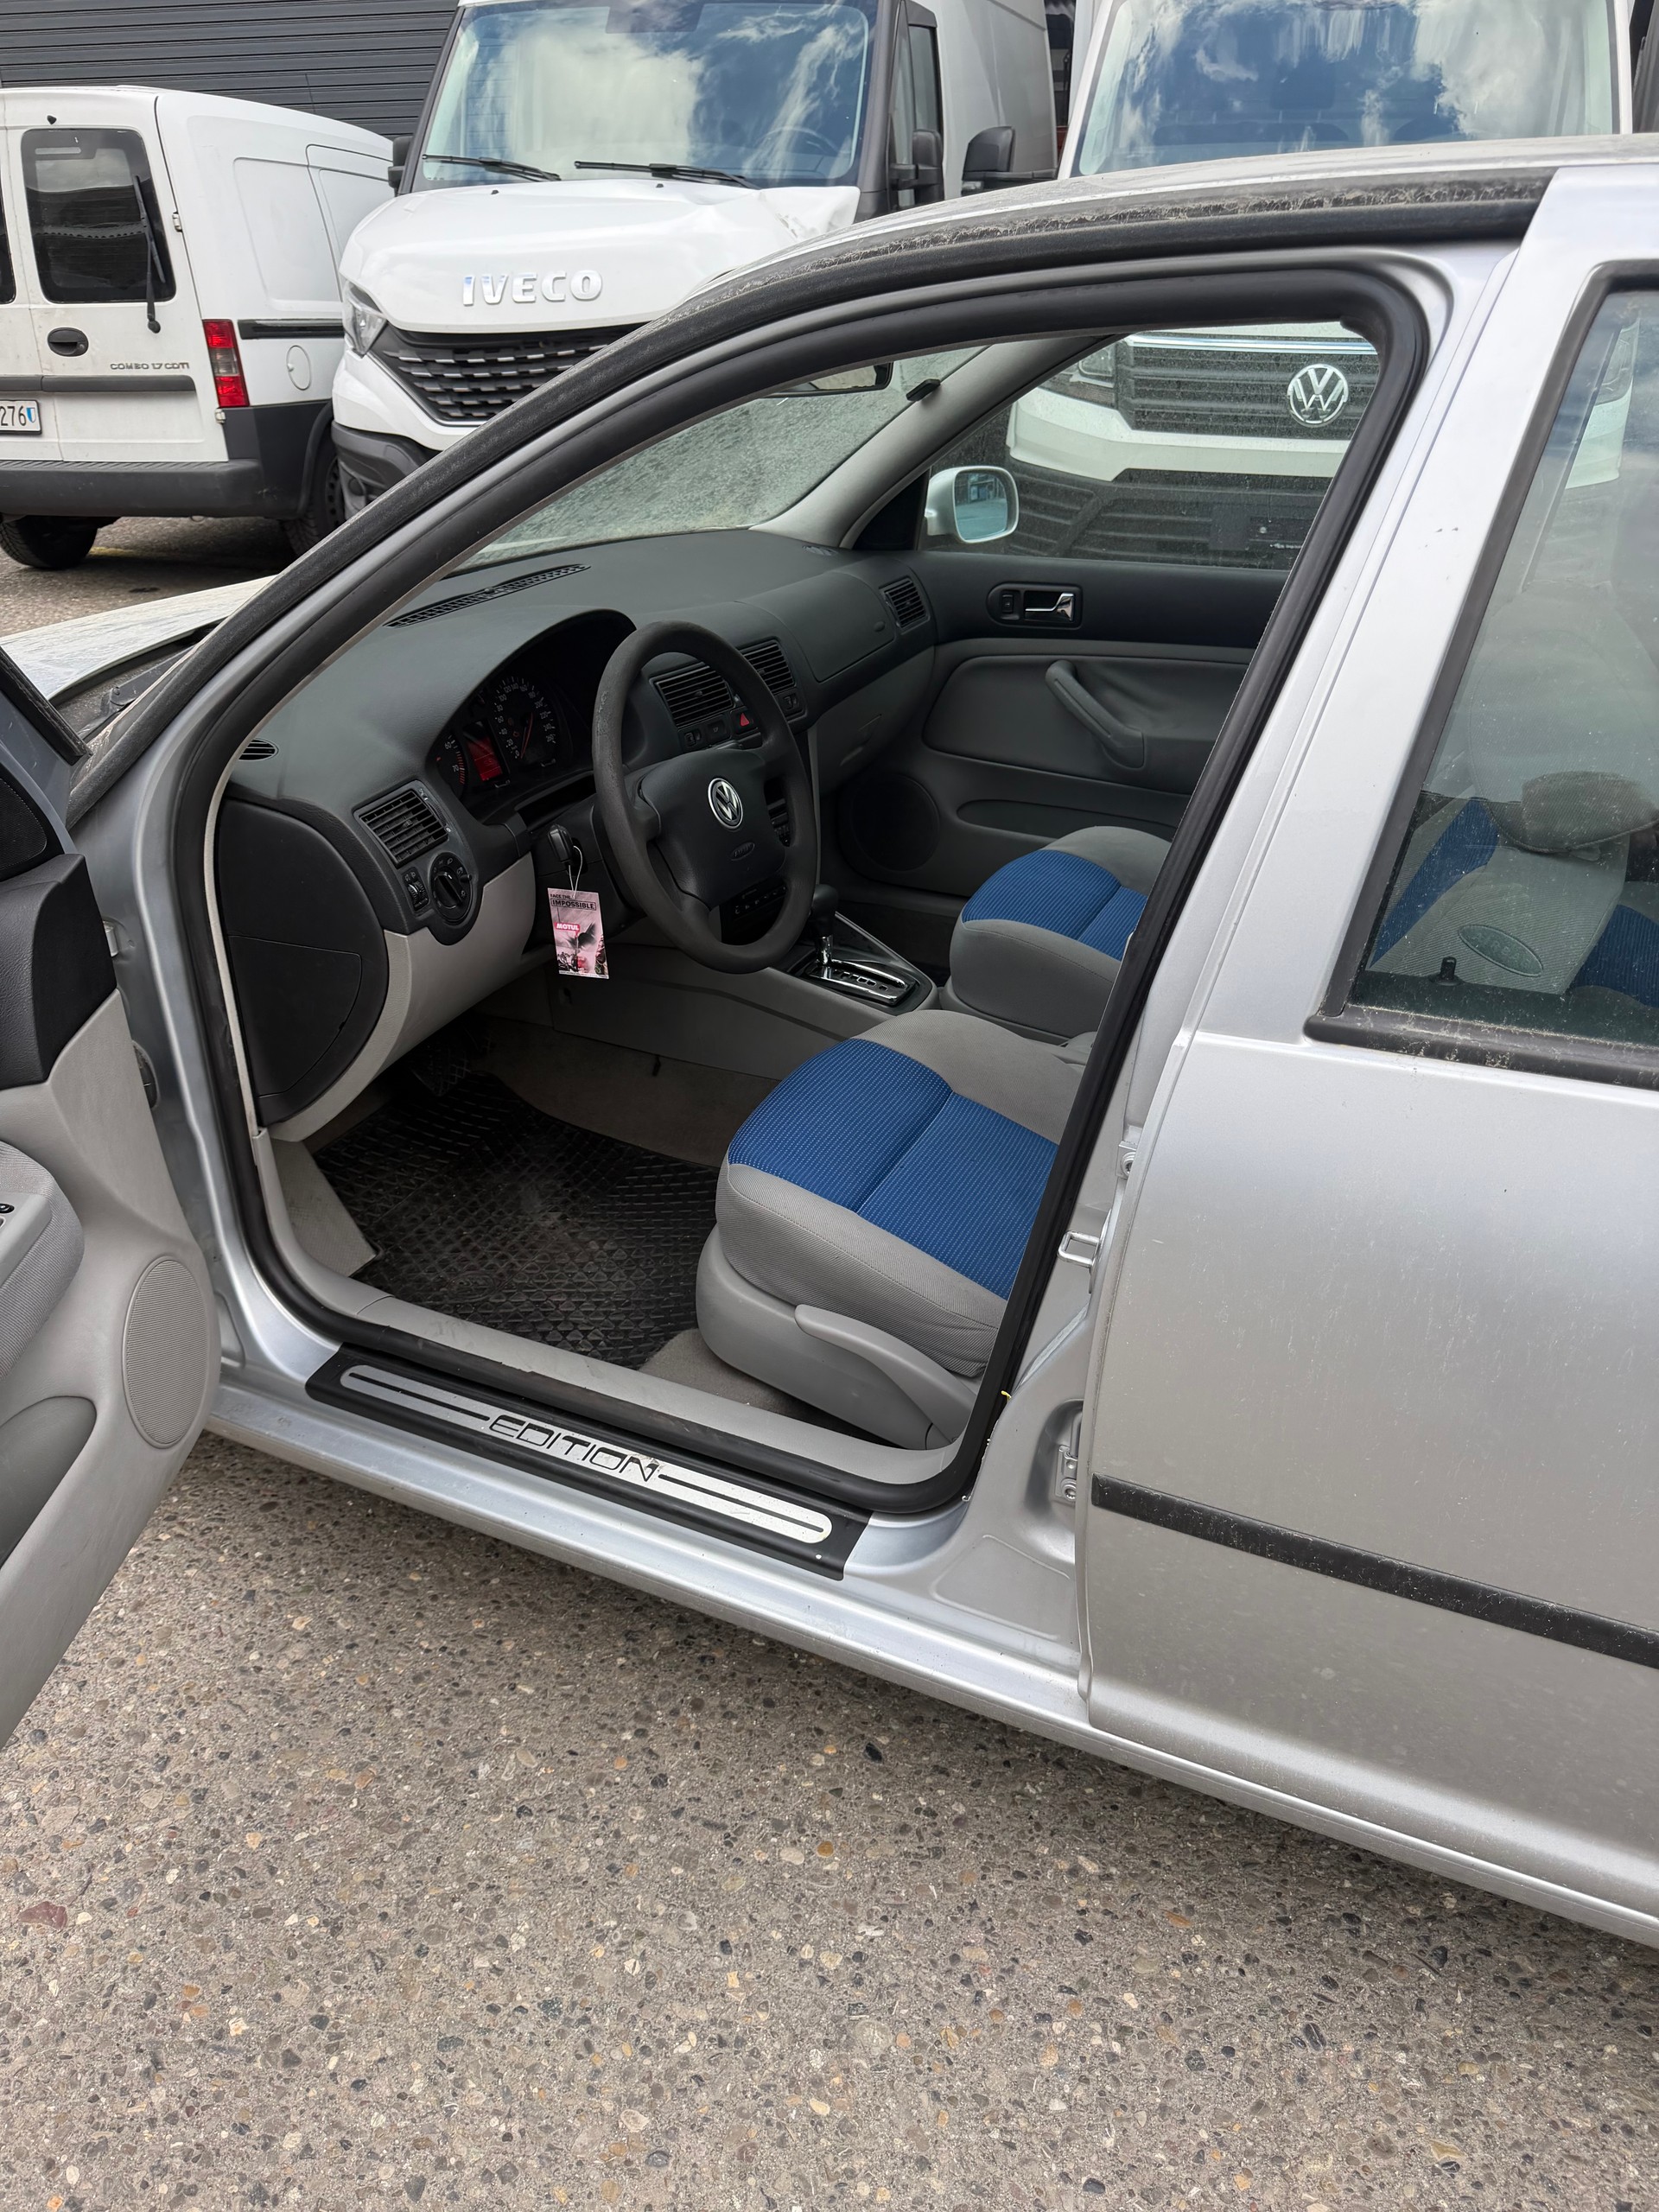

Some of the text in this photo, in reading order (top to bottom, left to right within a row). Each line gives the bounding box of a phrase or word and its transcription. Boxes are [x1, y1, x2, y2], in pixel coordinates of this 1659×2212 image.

[463, 270, 602, 307] IVECO
[0, 405, 27, 427] 276
[552, 899, 595, 909] IMPOSSIBLE
[489, 1414, 659, 1482] EDITION
